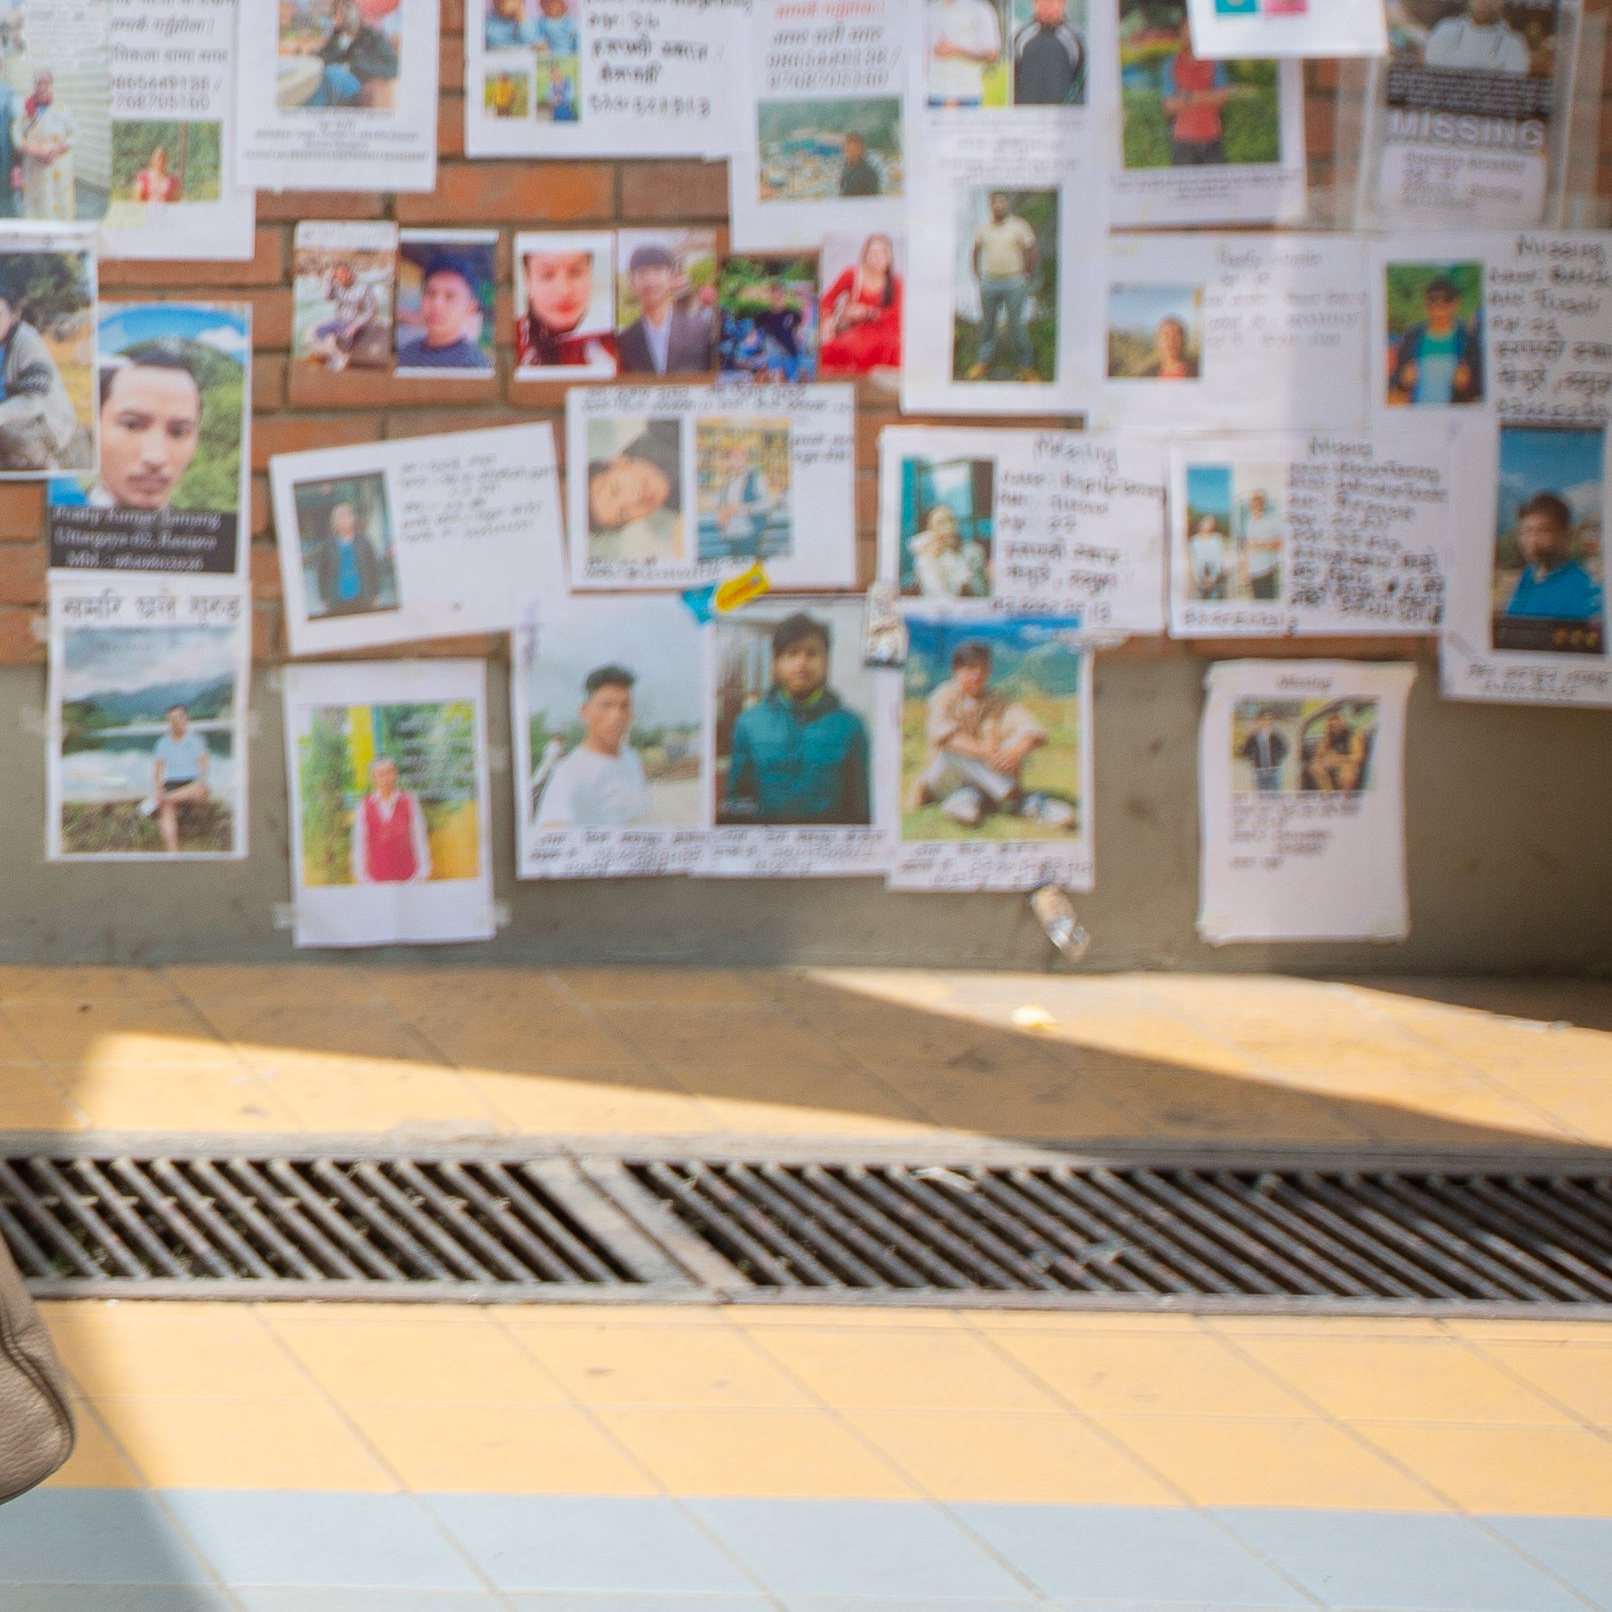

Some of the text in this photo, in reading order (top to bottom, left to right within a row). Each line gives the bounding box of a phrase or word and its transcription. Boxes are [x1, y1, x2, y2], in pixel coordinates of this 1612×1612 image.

[1389, 109, 1545, 150] MISSING
[1516, 232, 1607, 264] Missing
[1032, 438, 1118, 476] Missing
